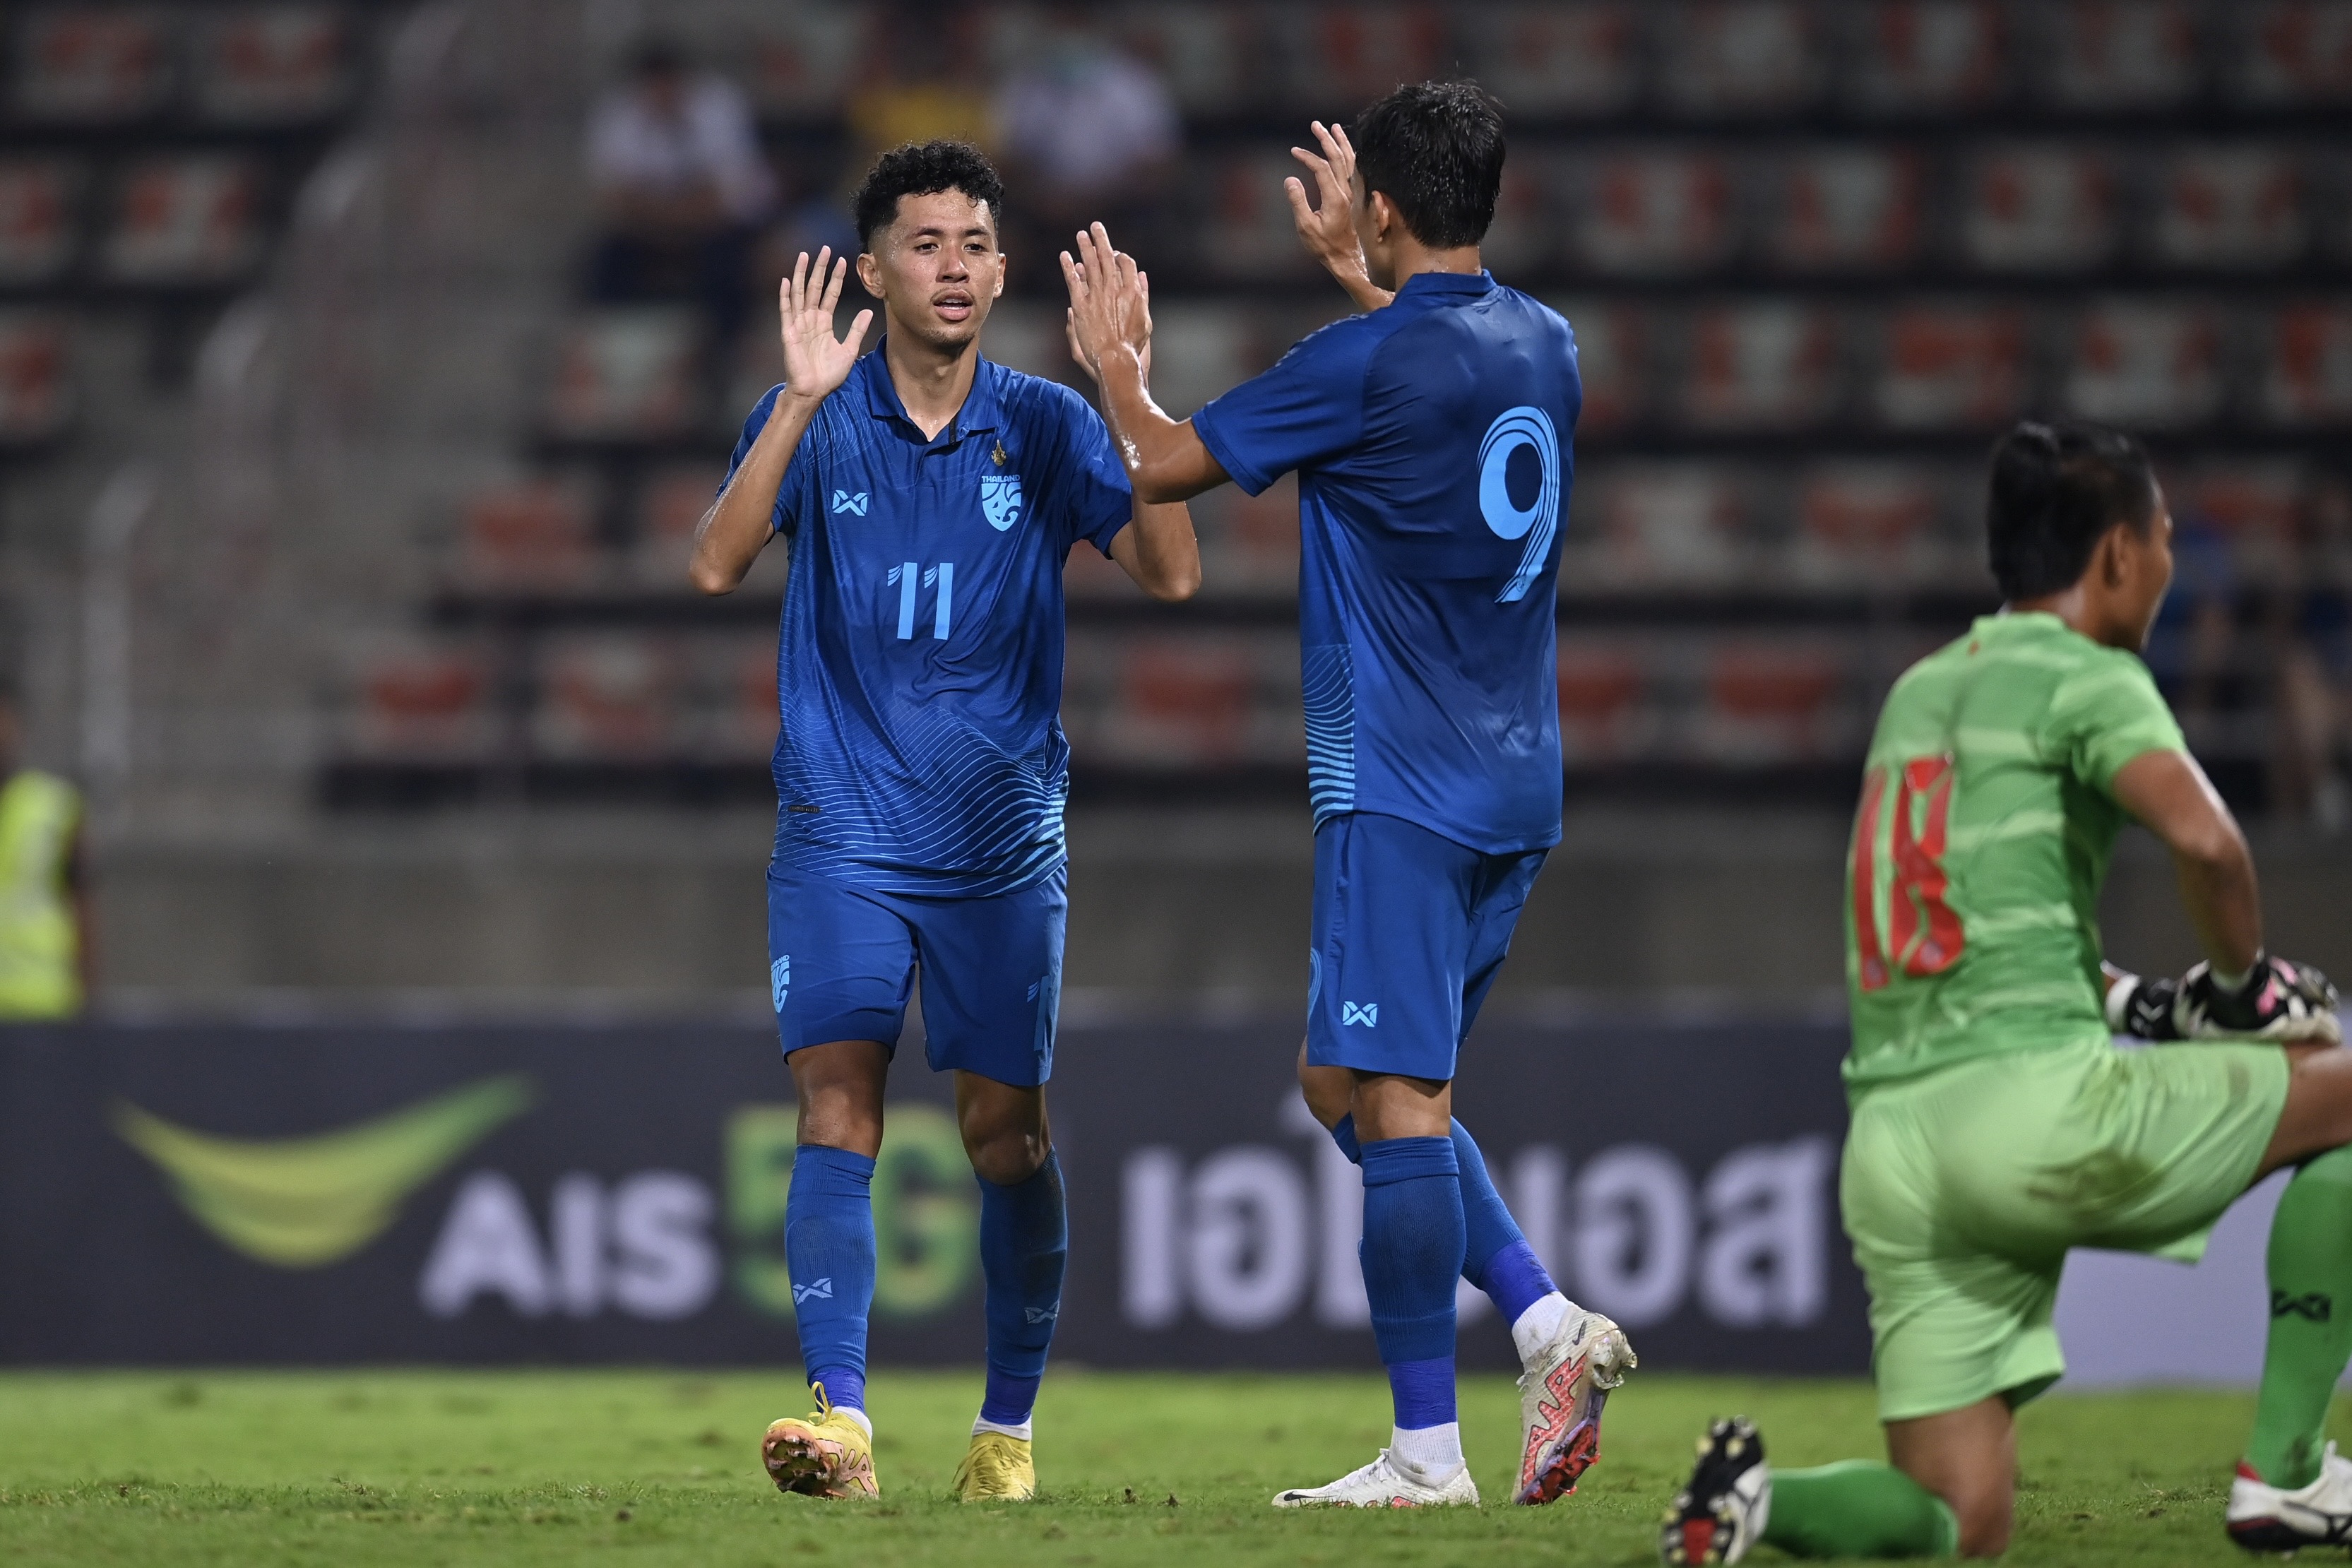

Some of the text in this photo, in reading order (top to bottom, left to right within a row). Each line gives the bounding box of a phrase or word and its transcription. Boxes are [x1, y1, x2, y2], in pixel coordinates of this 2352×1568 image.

[981, 474, 1021, 483] THAILAND
[1476, 405, 1560, 603] 9
[887, 562, 954, 641] 11
[1853, 756, 1965, 993] 18
[418, 1106, 985, 1319] AIS 5G
[1122, 1086, 1832, 1331] เอไเอส
